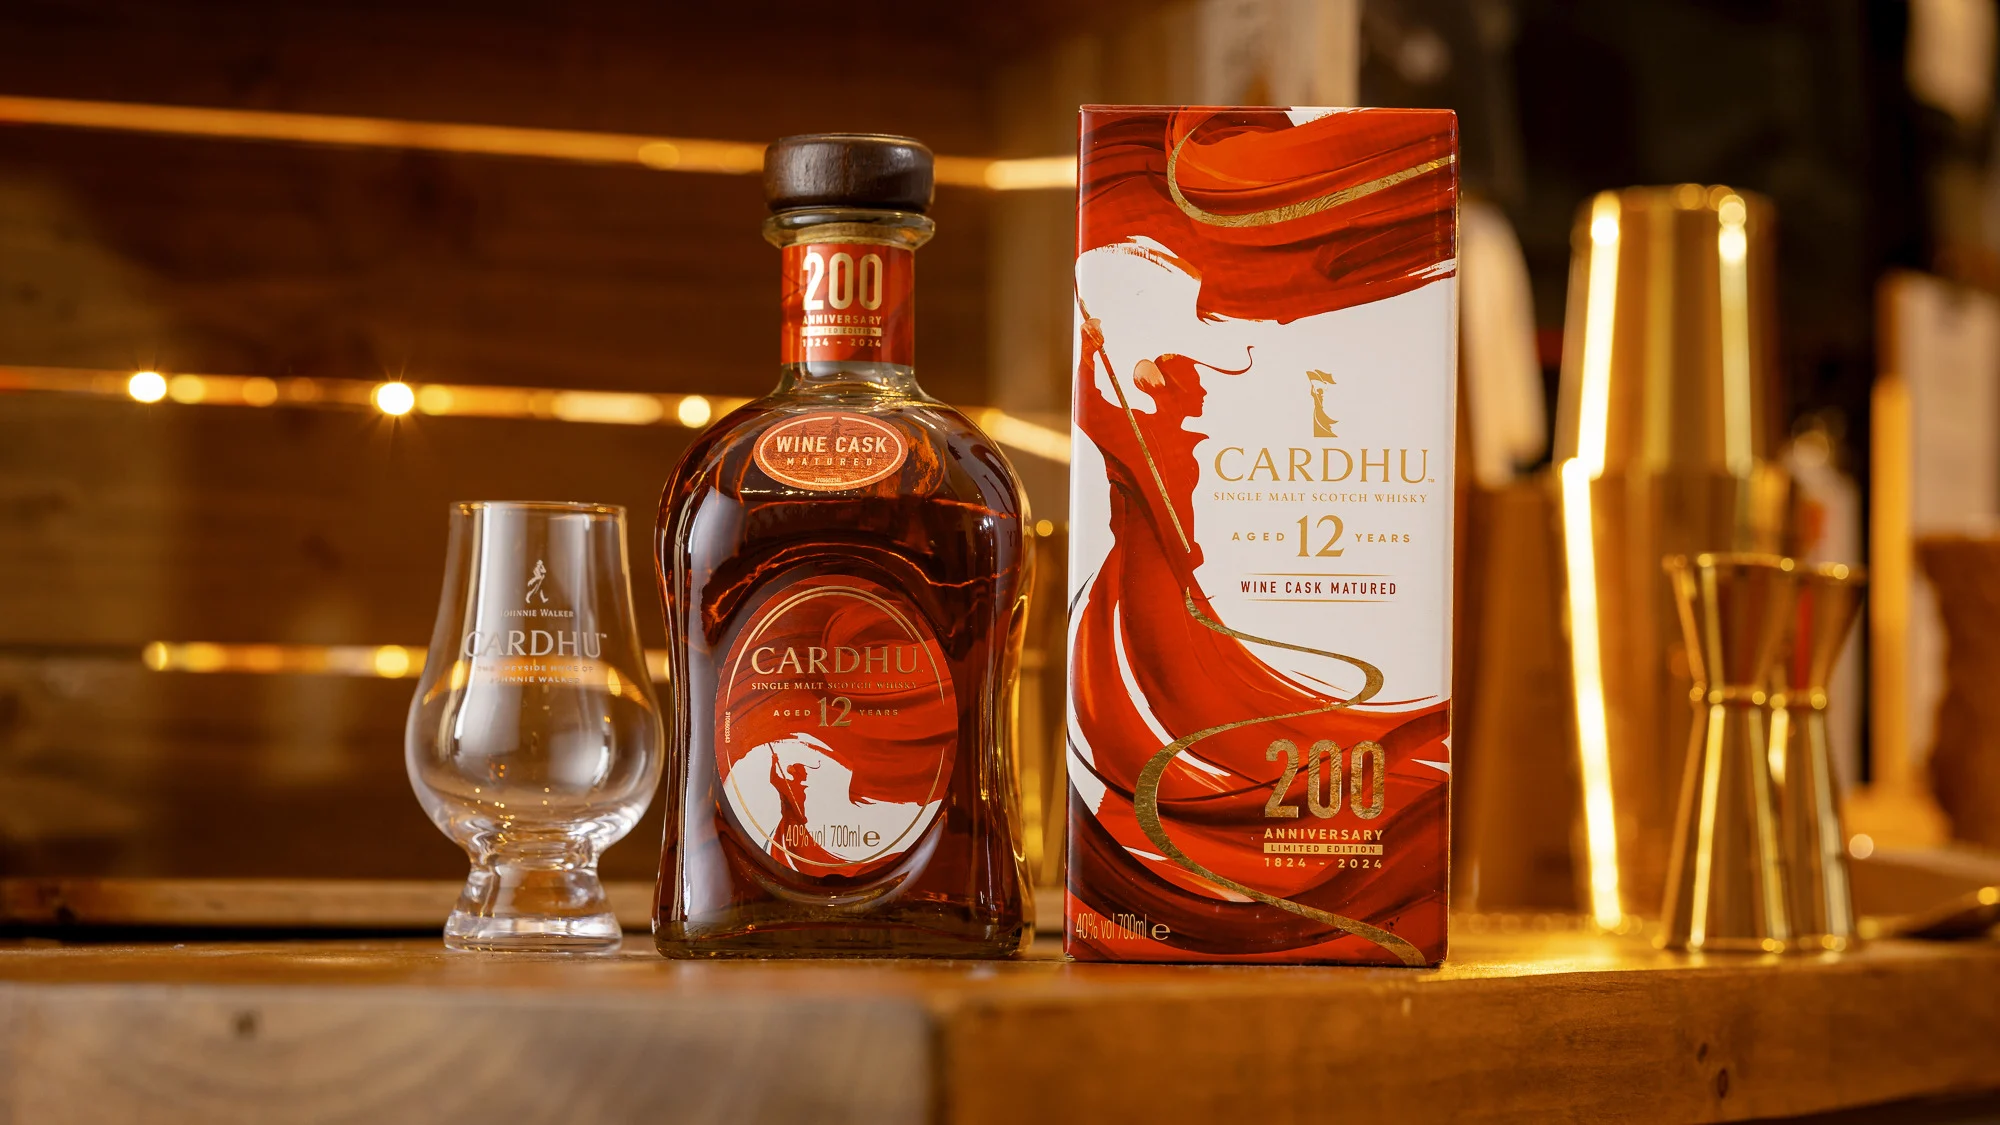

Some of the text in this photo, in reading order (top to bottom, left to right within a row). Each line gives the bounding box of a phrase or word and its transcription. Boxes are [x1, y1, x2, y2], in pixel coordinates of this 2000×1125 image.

[802, 252, 883, 311] 200
[802, 314, 882, 325] ANNIVERSARY
[842, 327, 877, 335] EDITION
[802, 338, 829, 348] 1824
[850, 338, 882, 348] 2024
[776, 436, 887, 453] WINE CASK
[786, 457, 873, 466] MATURED
[1213, 491, 1428, 503] SINGLE MALT SCOTCH WHISKY
[1231, 514, 1411, 558] AGED 12 YEARS
[1240, 581, 1397, 595] WINE CASK MATURED
[540, 608, 574, 618] WALKER
[499, 664, 547, 672] PEYSIDE
[751, 682, 918, 690] SINGLE MALT SCOTCH WHISKY
[773, 696, 899, 727] AGED 12 YEARS
[1264, 738, 1386, 820] 200
[785, 824, 809, 847] 40%
[811, 824, 826, 847] vol
[830, 824, 861, 848] 700ml
[1264, 828, 1384, 841] ANNIVERSARY
[1270, 844, 1376, 854] LIMITED EDITION
[1264, 857, 1306, 868] 1824
[1337, 858, 1383, 869] 2024
[1075, 912, 1098, 939] 40%
[1101, 913, 1115, 940] vol
[1117, 913, 1147, 940] 700ml
